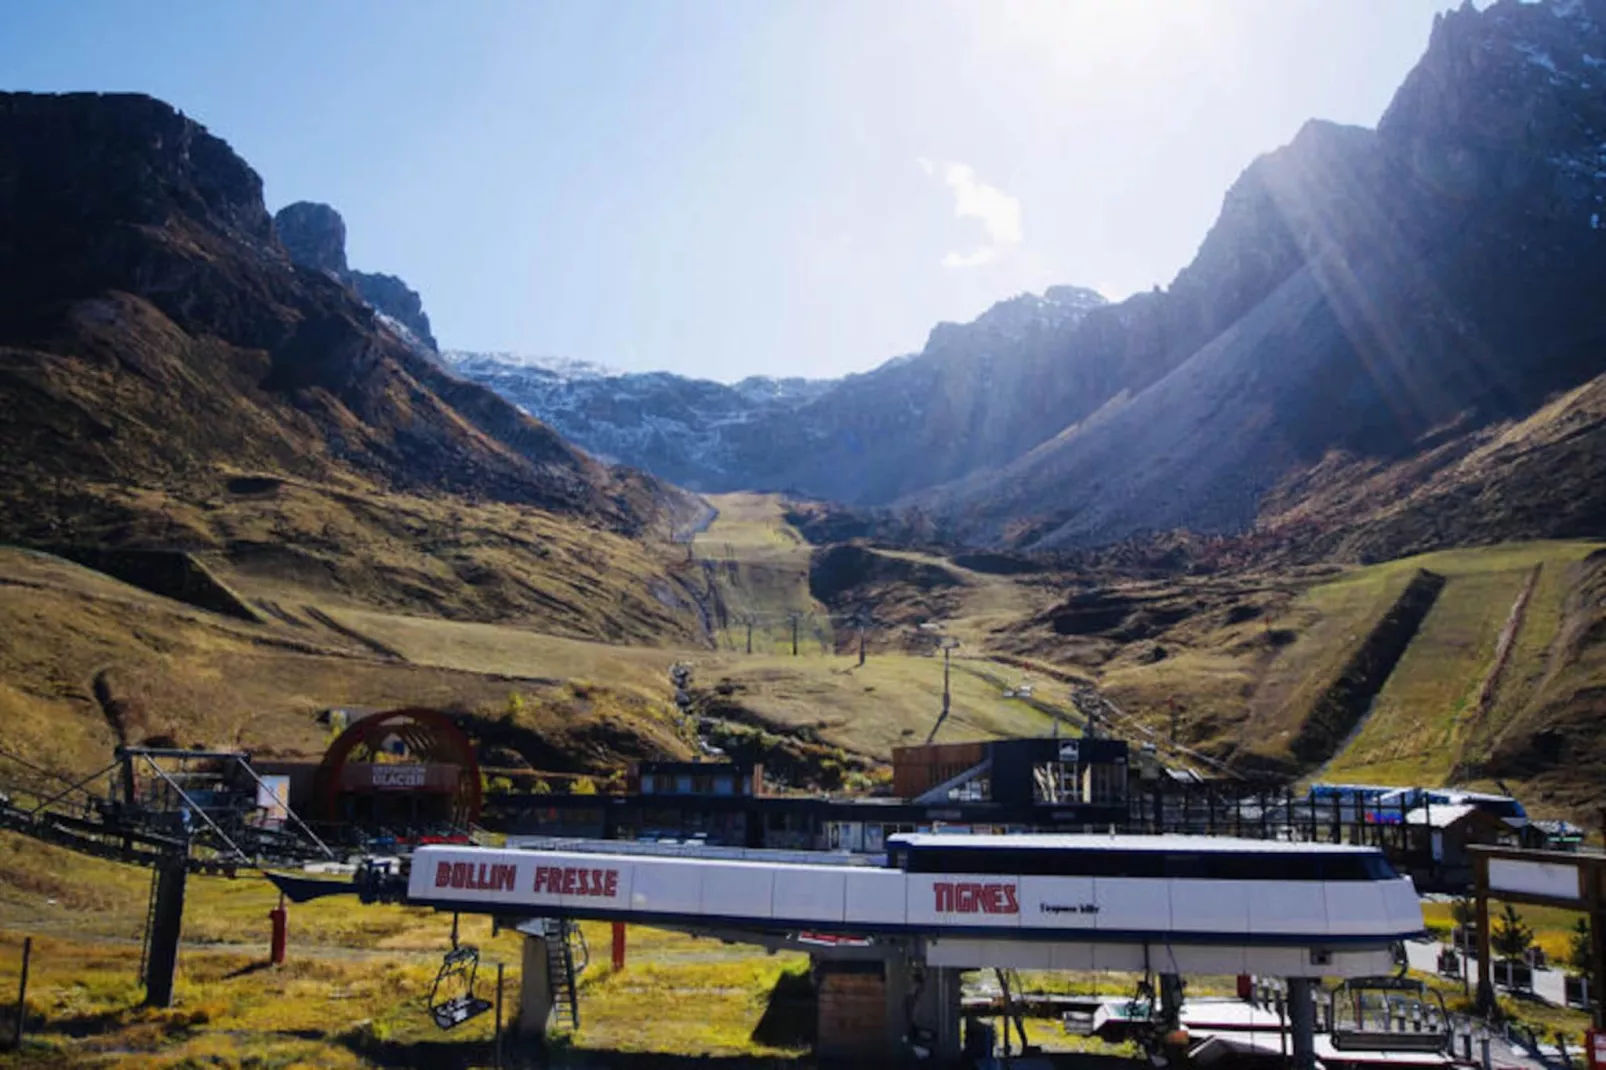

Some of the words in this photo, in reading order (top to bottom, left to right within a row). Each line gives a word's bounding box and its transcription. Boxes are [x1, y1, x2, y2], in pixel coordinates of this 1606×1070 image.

[435, 861, 516, 891] BOLLIN
[534, 866, 619, 897] FRESSE
[933, 882, 1019, 914] TIGNES
